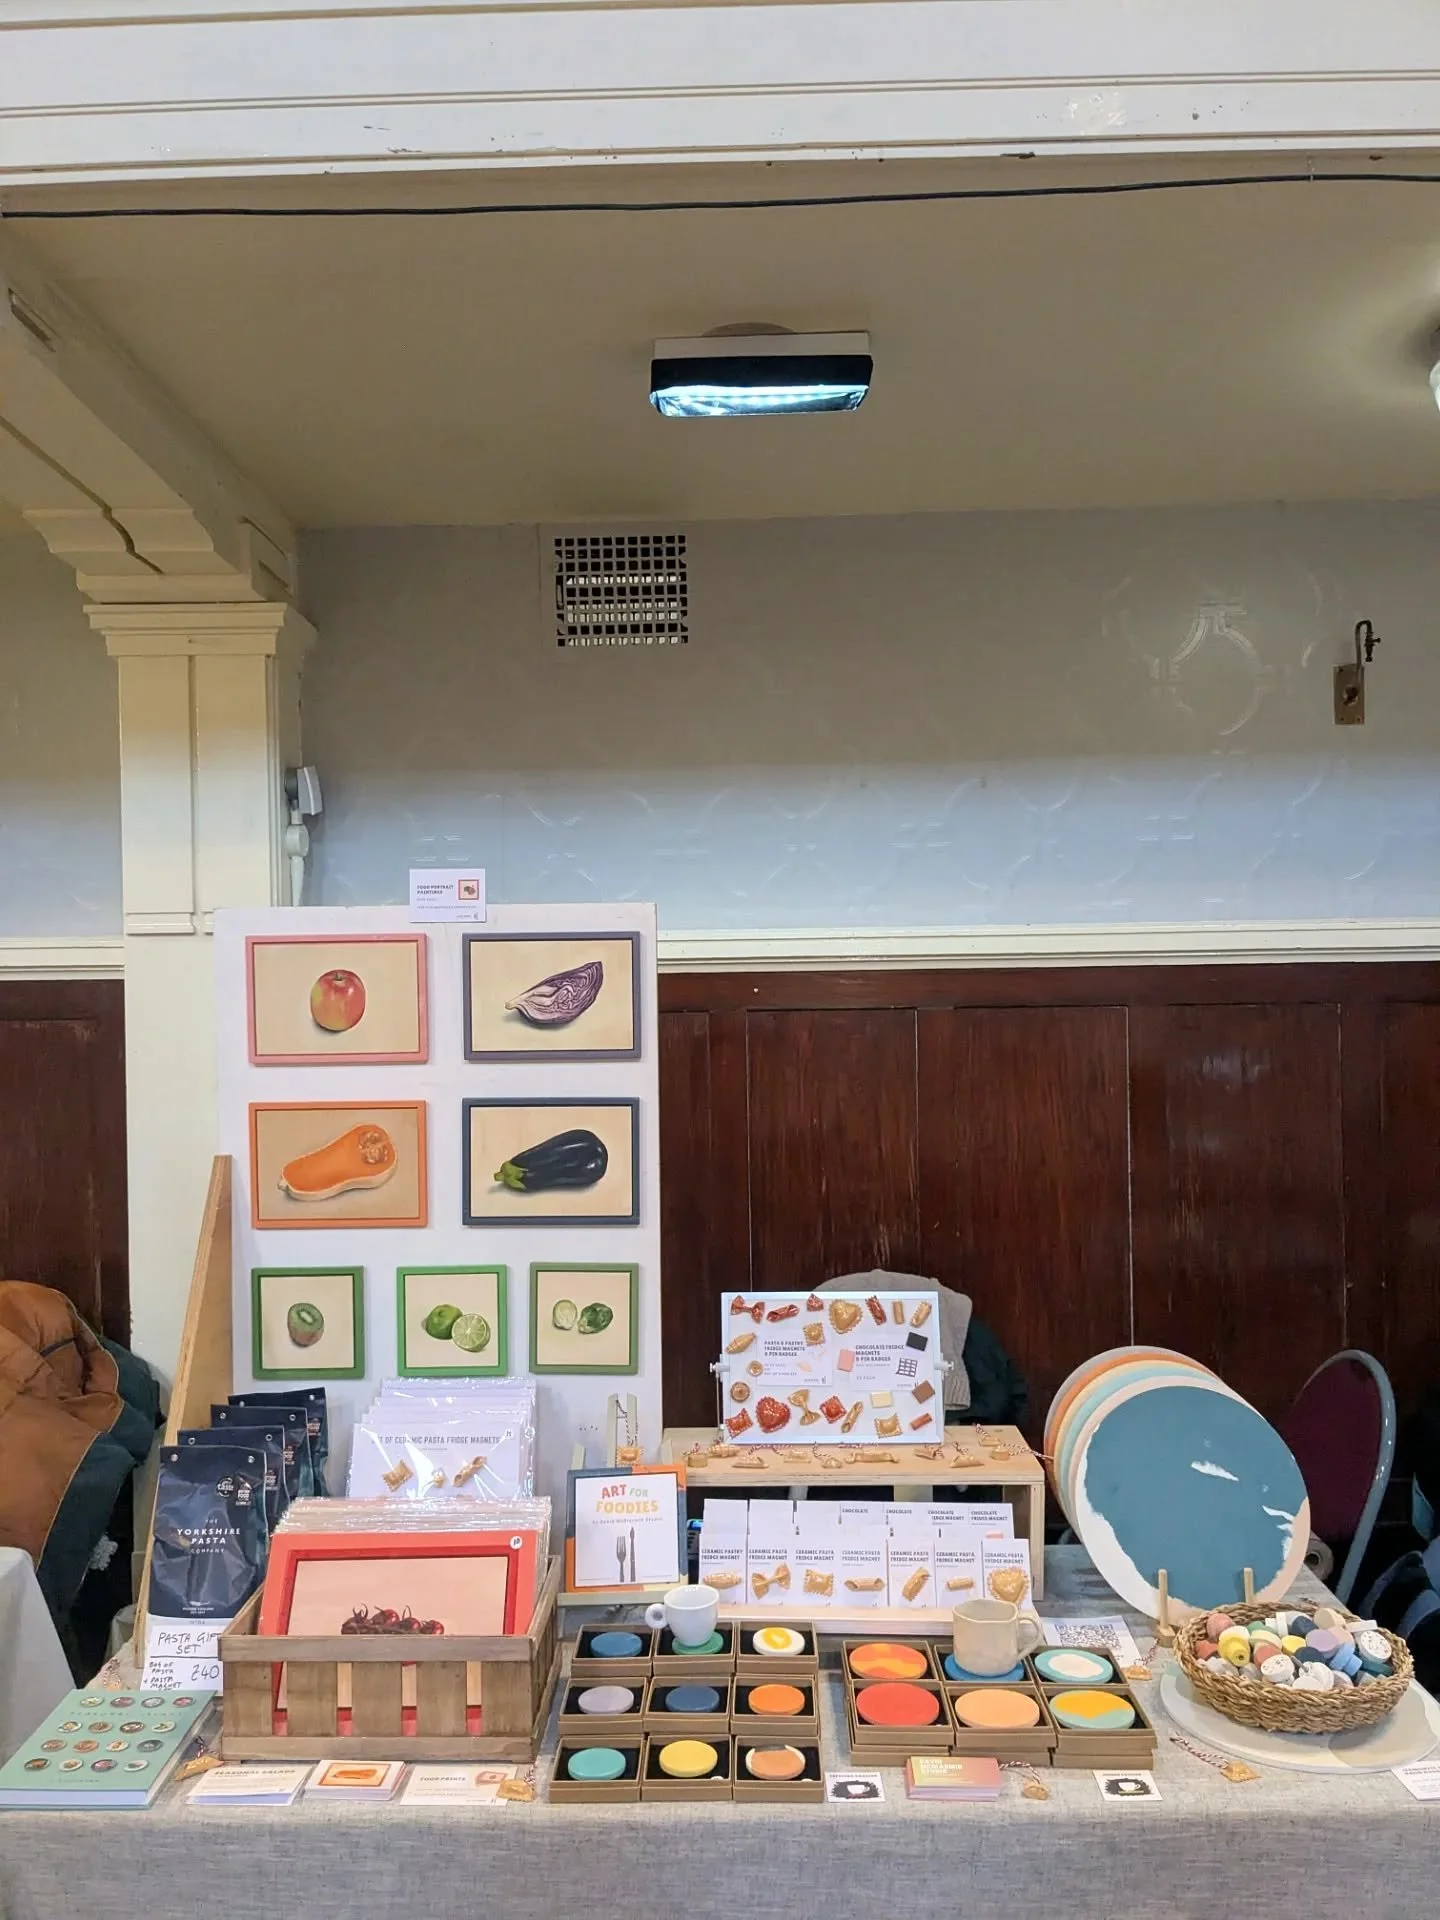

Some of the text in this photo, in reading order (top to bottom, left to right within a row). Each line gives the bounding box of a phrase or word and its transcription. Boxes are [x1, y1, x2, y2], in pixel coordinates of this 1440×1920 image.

[394, 1436, 423, 1444] CERMIC
[424, 1436, 445, 1444] PASTA
[446, 1436, 469, 1444] FRIDGE
[601, 1483, 649, 1499] ART FOR
[595, 1500, 659, 1513] FOODIES
[177, 1528, 241, 1536] YORKSHIRE
[191, 1537, 226, 1545] PASTA
[158, 1632, 191, 1646] PASTA
[176, 1644, 201, 1655] SET
[191, 1664, 220, 1681] £40
[150, 1675, 174, 1683] PASTA
